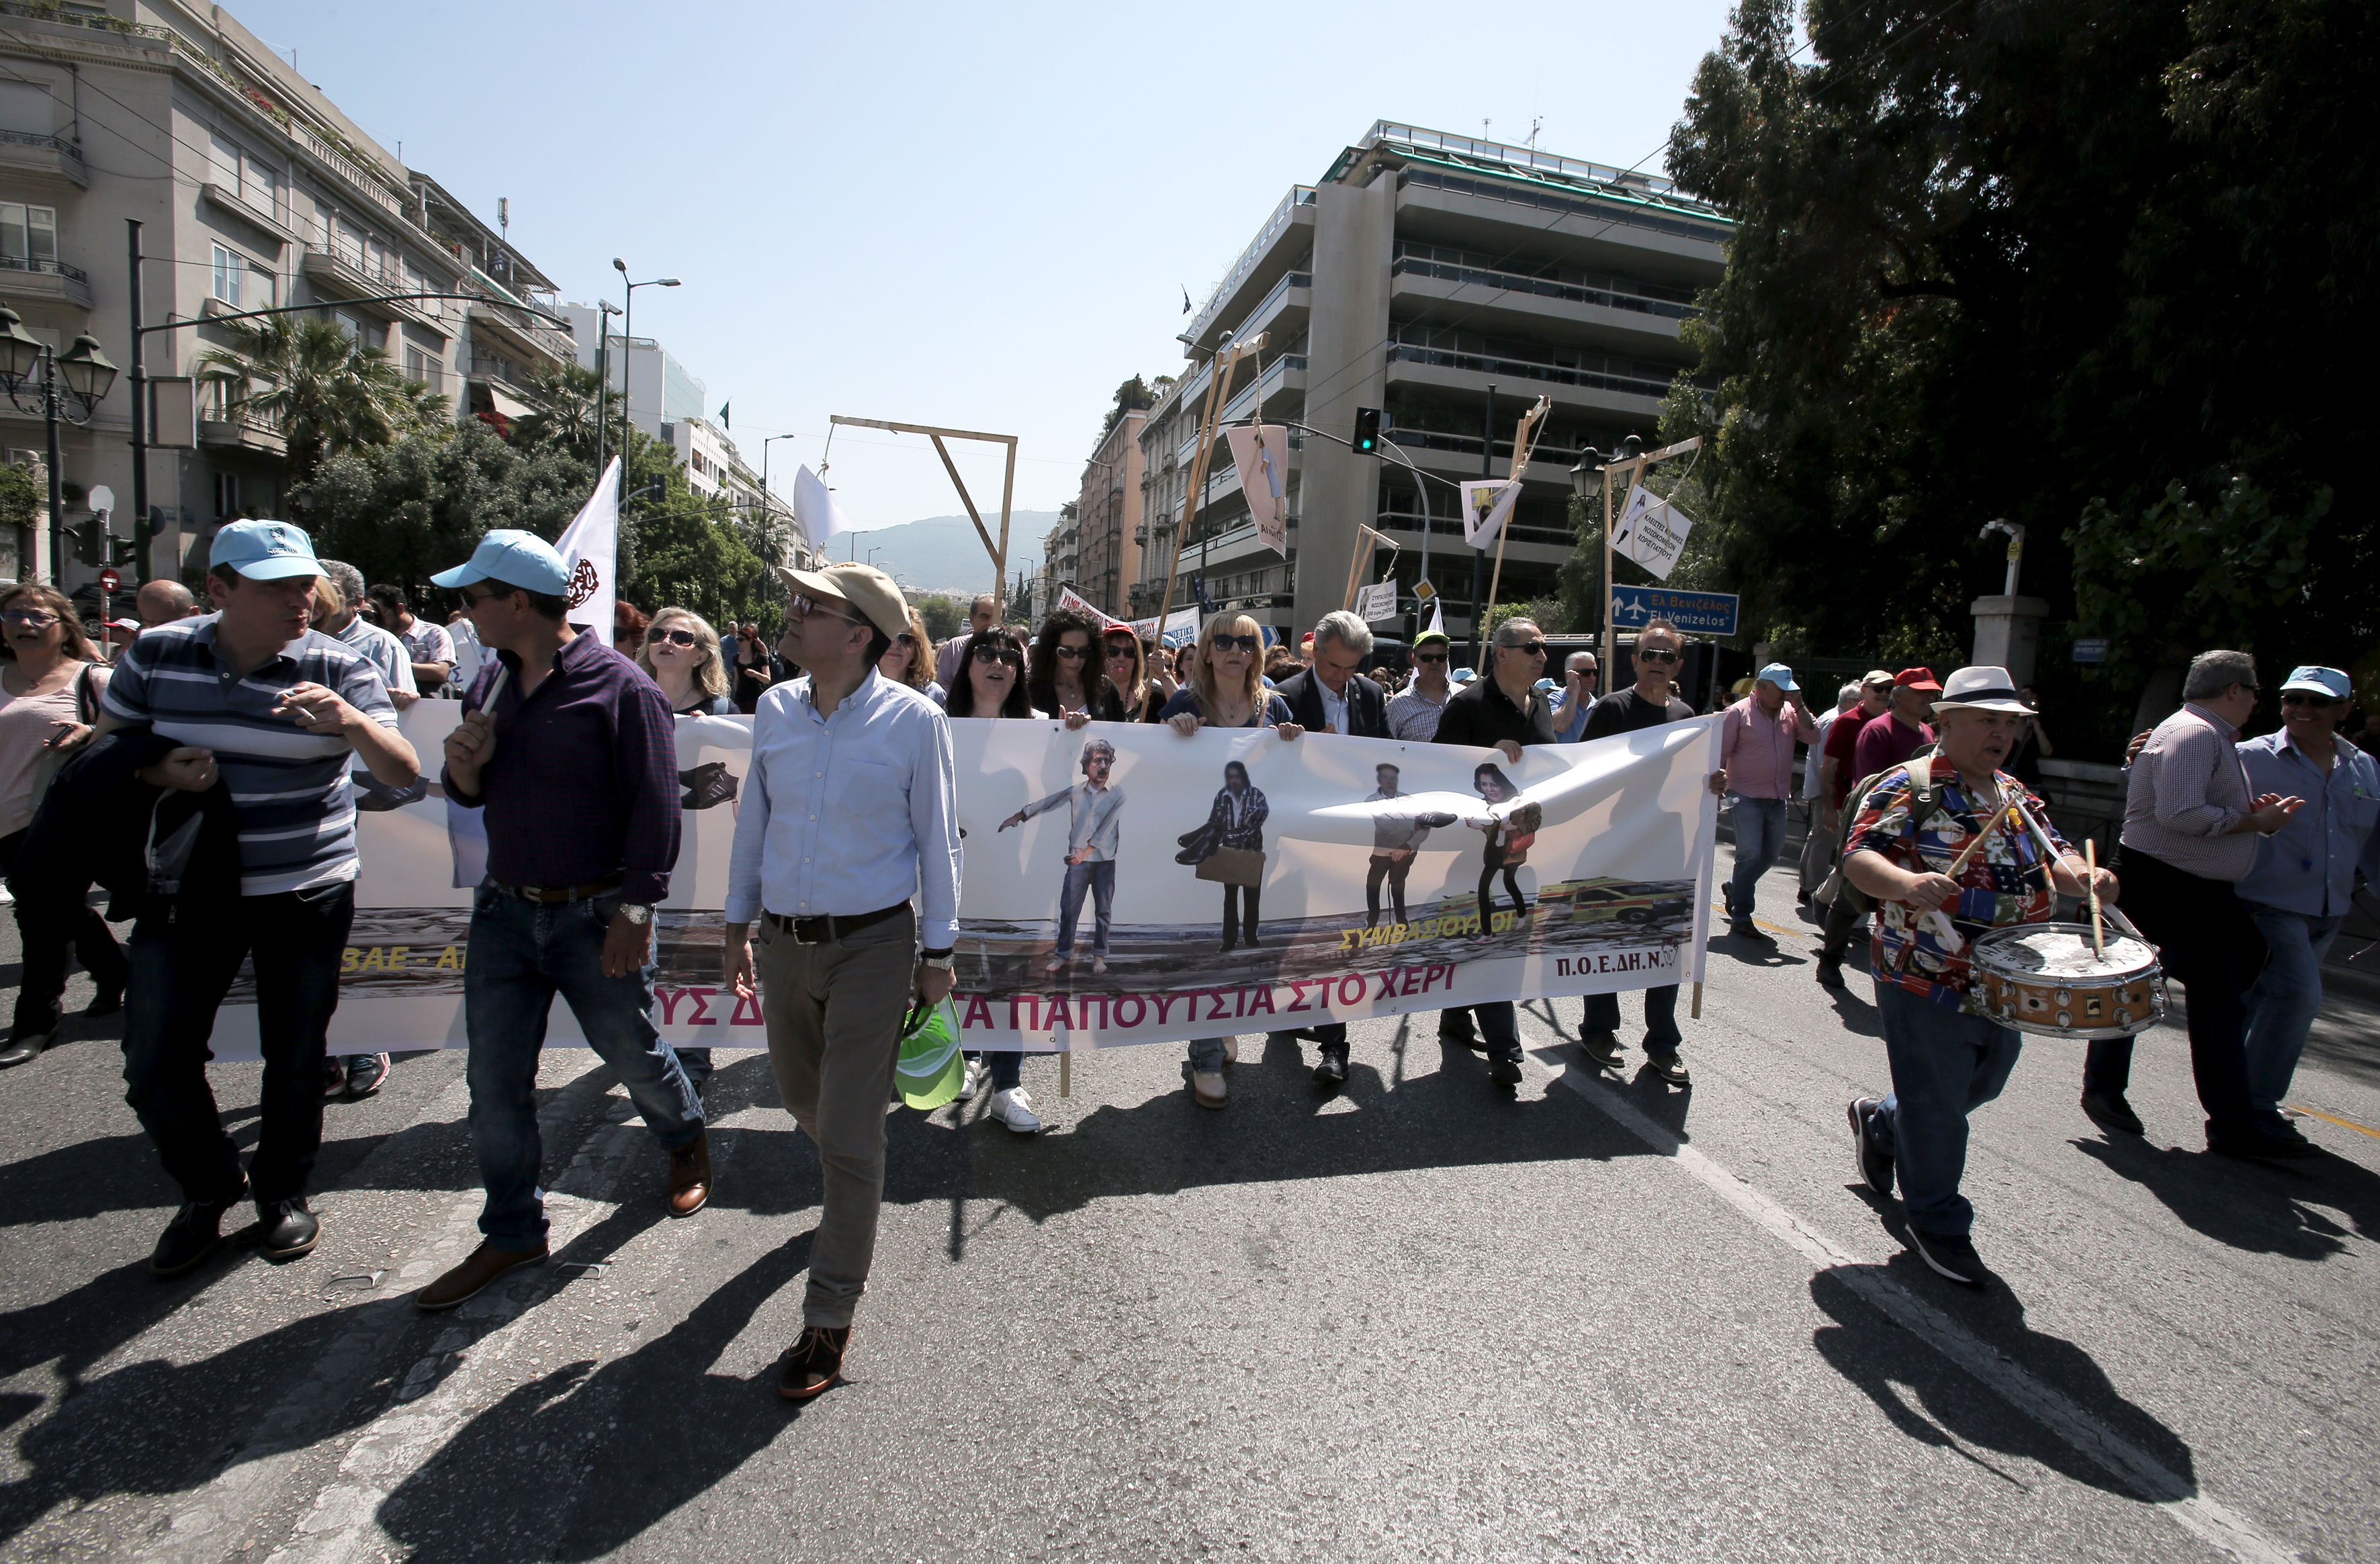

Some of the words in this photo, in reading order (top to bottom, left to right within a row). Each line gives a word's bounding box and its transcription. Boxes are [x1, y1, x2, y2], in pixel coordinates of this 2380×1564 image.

[1644, 514, 1665, 532] ΚΛΕΙΣΤΕΣ
[1637, 534, 1652, 547] ΧΩΡΙΣ
[654, 987, 717, 1025] ΥΣ
[1010, 984, 1275, 1031] ΠΑΠΟΥΤΣΙΑ
[1286, 974, 1366, 1013] ΣΤΟ
[1374, 964, 1458, 1001] ΧΕΡΙ
